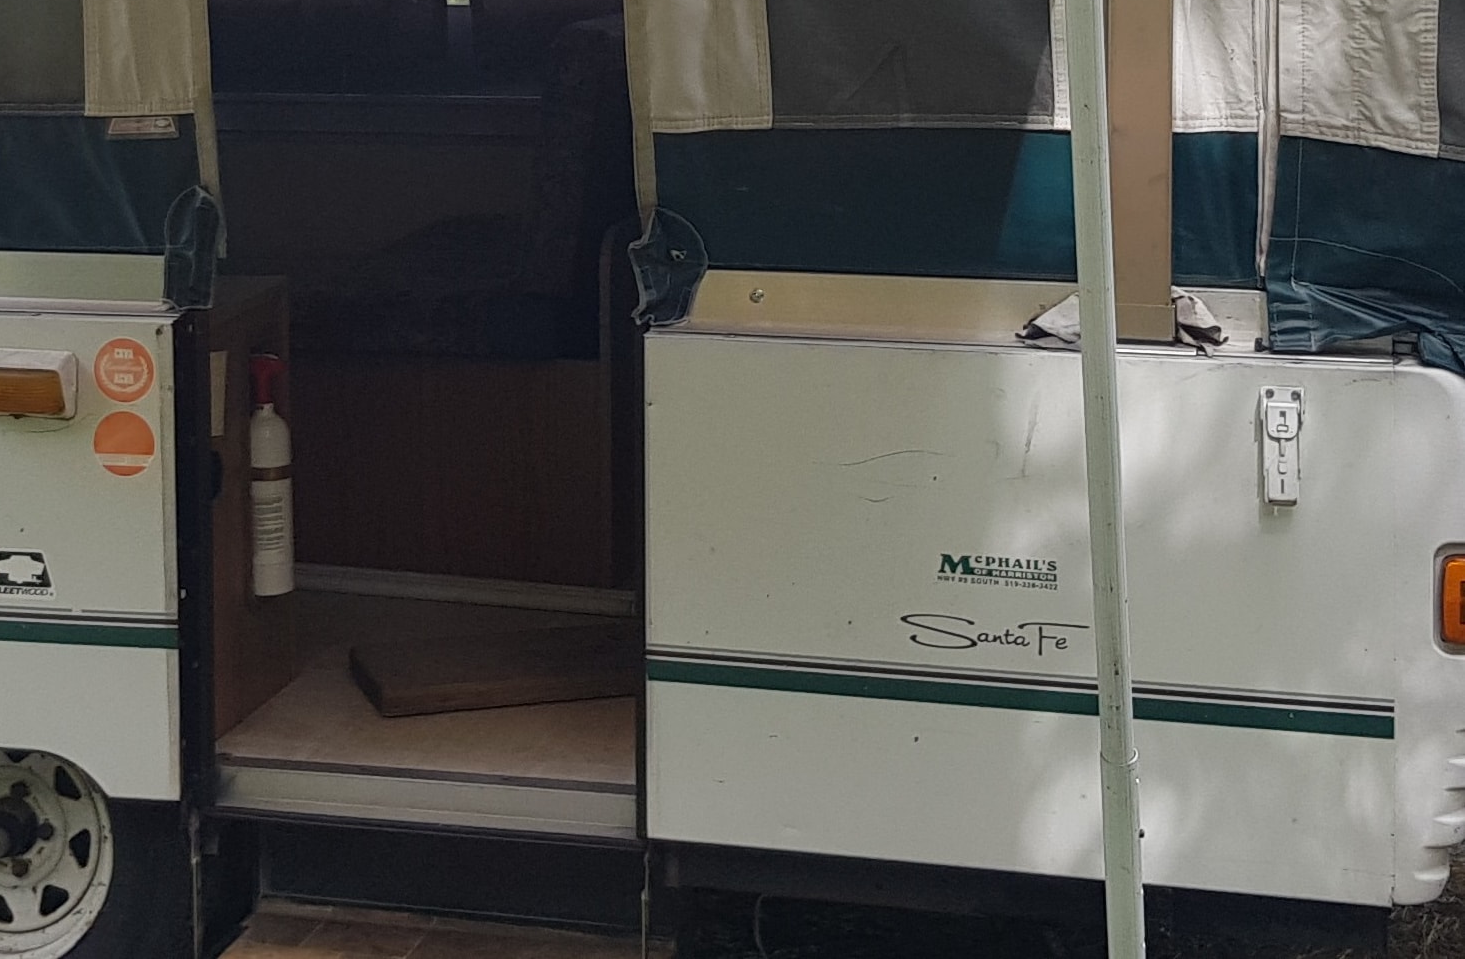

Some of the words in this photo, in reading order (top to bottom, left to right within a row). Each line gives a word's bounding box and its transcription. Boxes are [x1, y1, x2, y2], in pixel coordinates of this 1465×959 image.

[973, 568, 989, 576] OF
[992, 569, 1055, 581] HARRISTON
[970, 577, 1000, 586] SOUTH
[900, 614, 1030, 650] Santa
[1018, 623, 1090, 656] Fe
